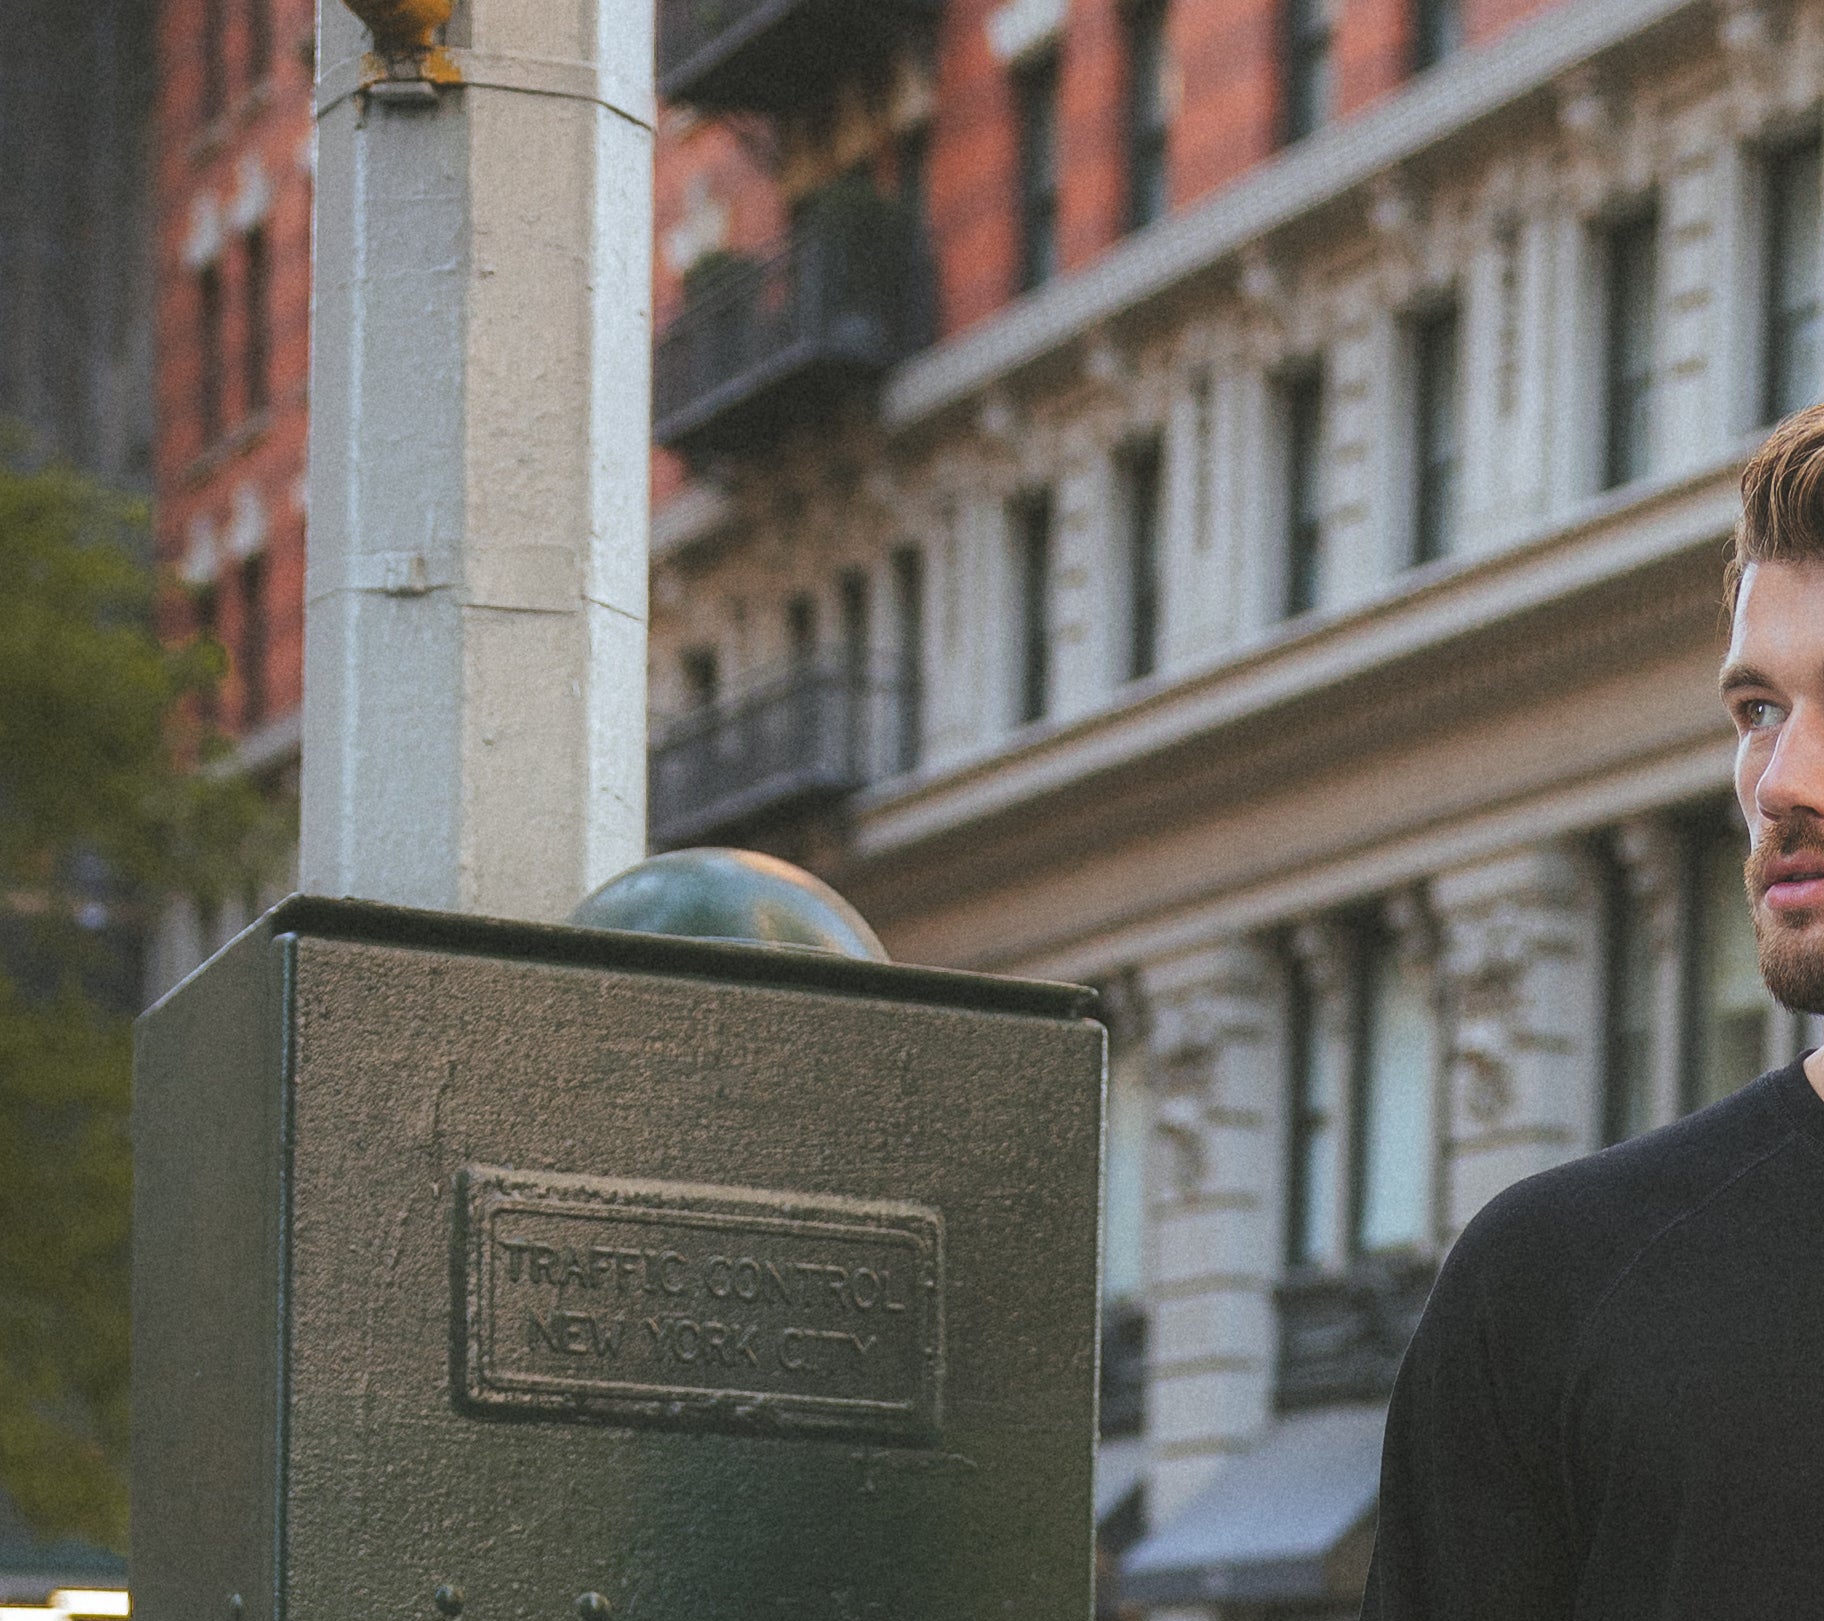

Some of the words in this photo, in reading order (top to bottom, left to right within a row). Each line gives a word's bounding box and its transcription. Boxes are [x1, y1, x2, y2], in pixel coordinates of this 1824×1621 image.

[499, 1237, 687, 1296] TRAFFIC
[706, 1255, 906, 1312] CONTROL
[528, 1309, 624, 1359] NEW
[645, 1316, 760, 1367] YORK
[778, 1326, 879, 1373] CITY
